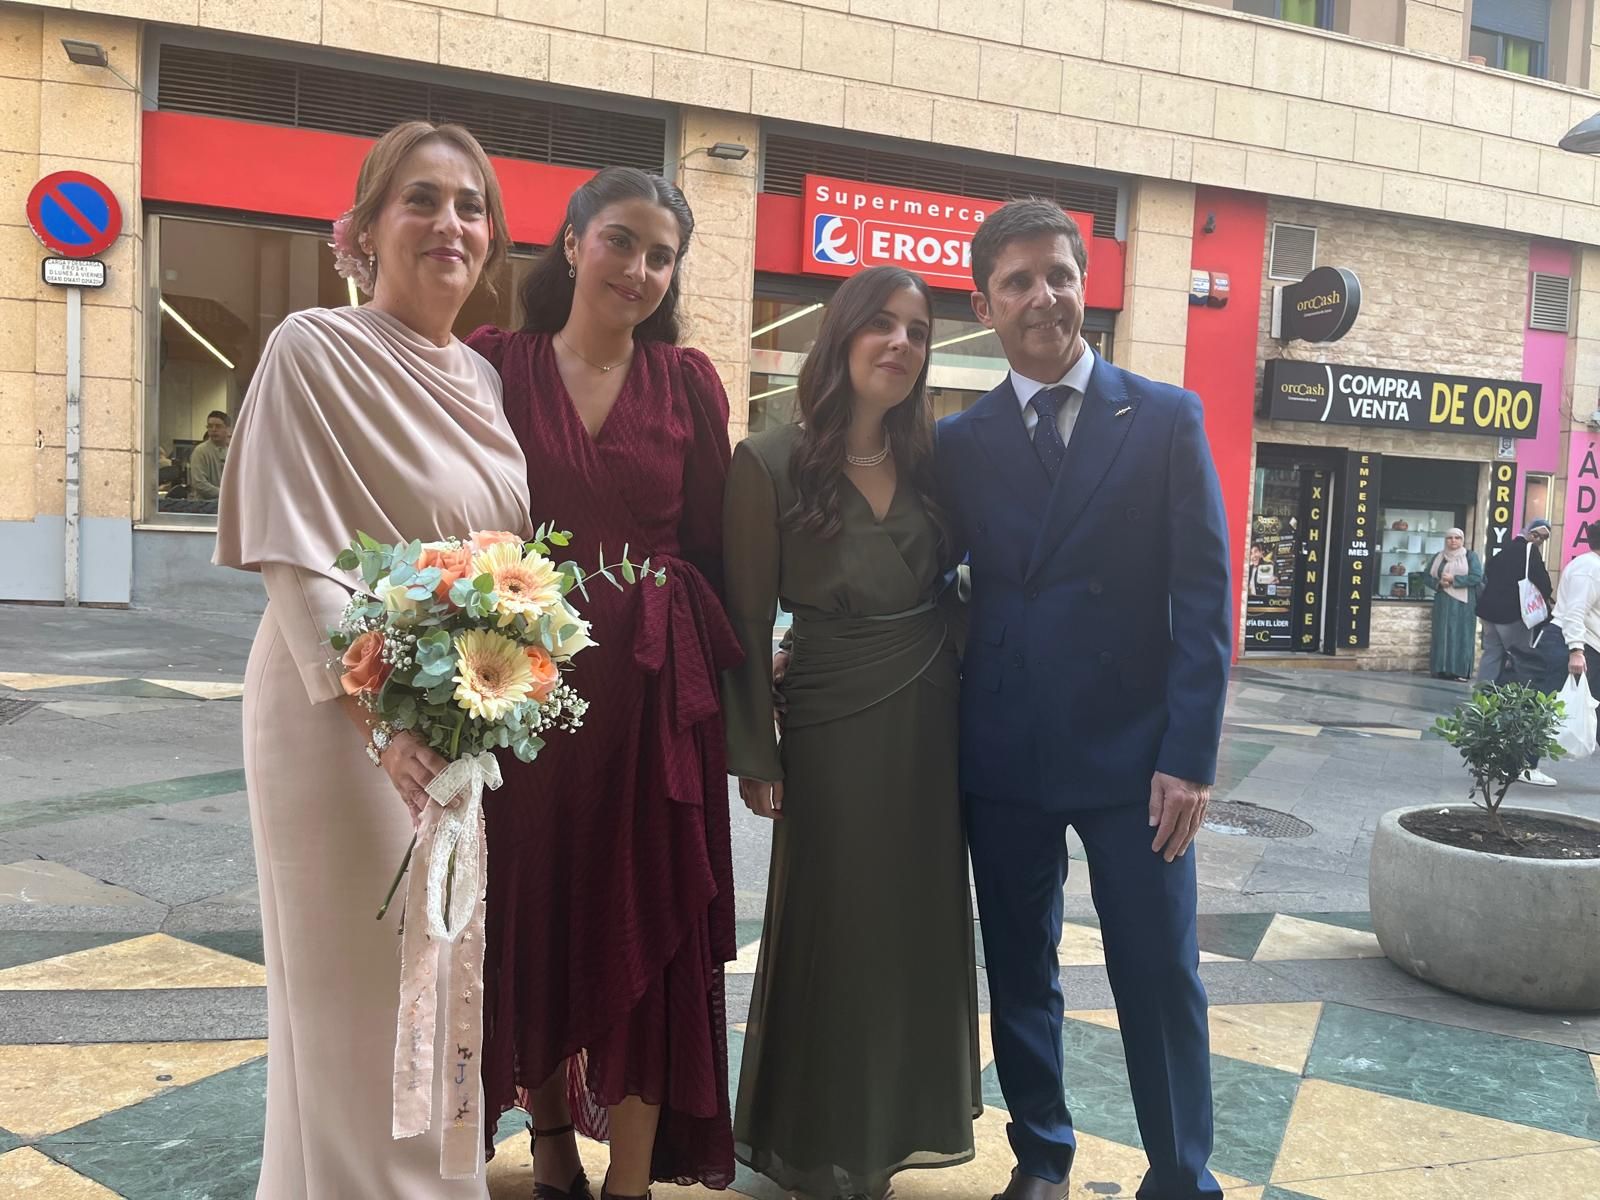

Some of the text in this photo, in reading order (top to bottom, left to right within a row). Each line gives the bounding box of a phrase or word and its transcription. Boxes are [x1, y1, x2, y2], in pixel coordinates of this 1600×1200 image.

[815, 185, 985, 223] Supermerca
[1338, 373, 1422, 400] COMPRA
[1348, 397, 1409, 422] VENTA
[1429, 382, 1533, 431] DE ORO
[1355, 455, 1369, 537] EMPEÑOS
[1572, 442, 1600, 560] ÁDA
[1348, 549, 1369, 557] MES
[1351, 540, 1367, 549] UN
[1349, 560, 1363, 644] GRATIS
[1257, 619, 1265, 627] EN
[1266, 619, 1273, 627] EL
